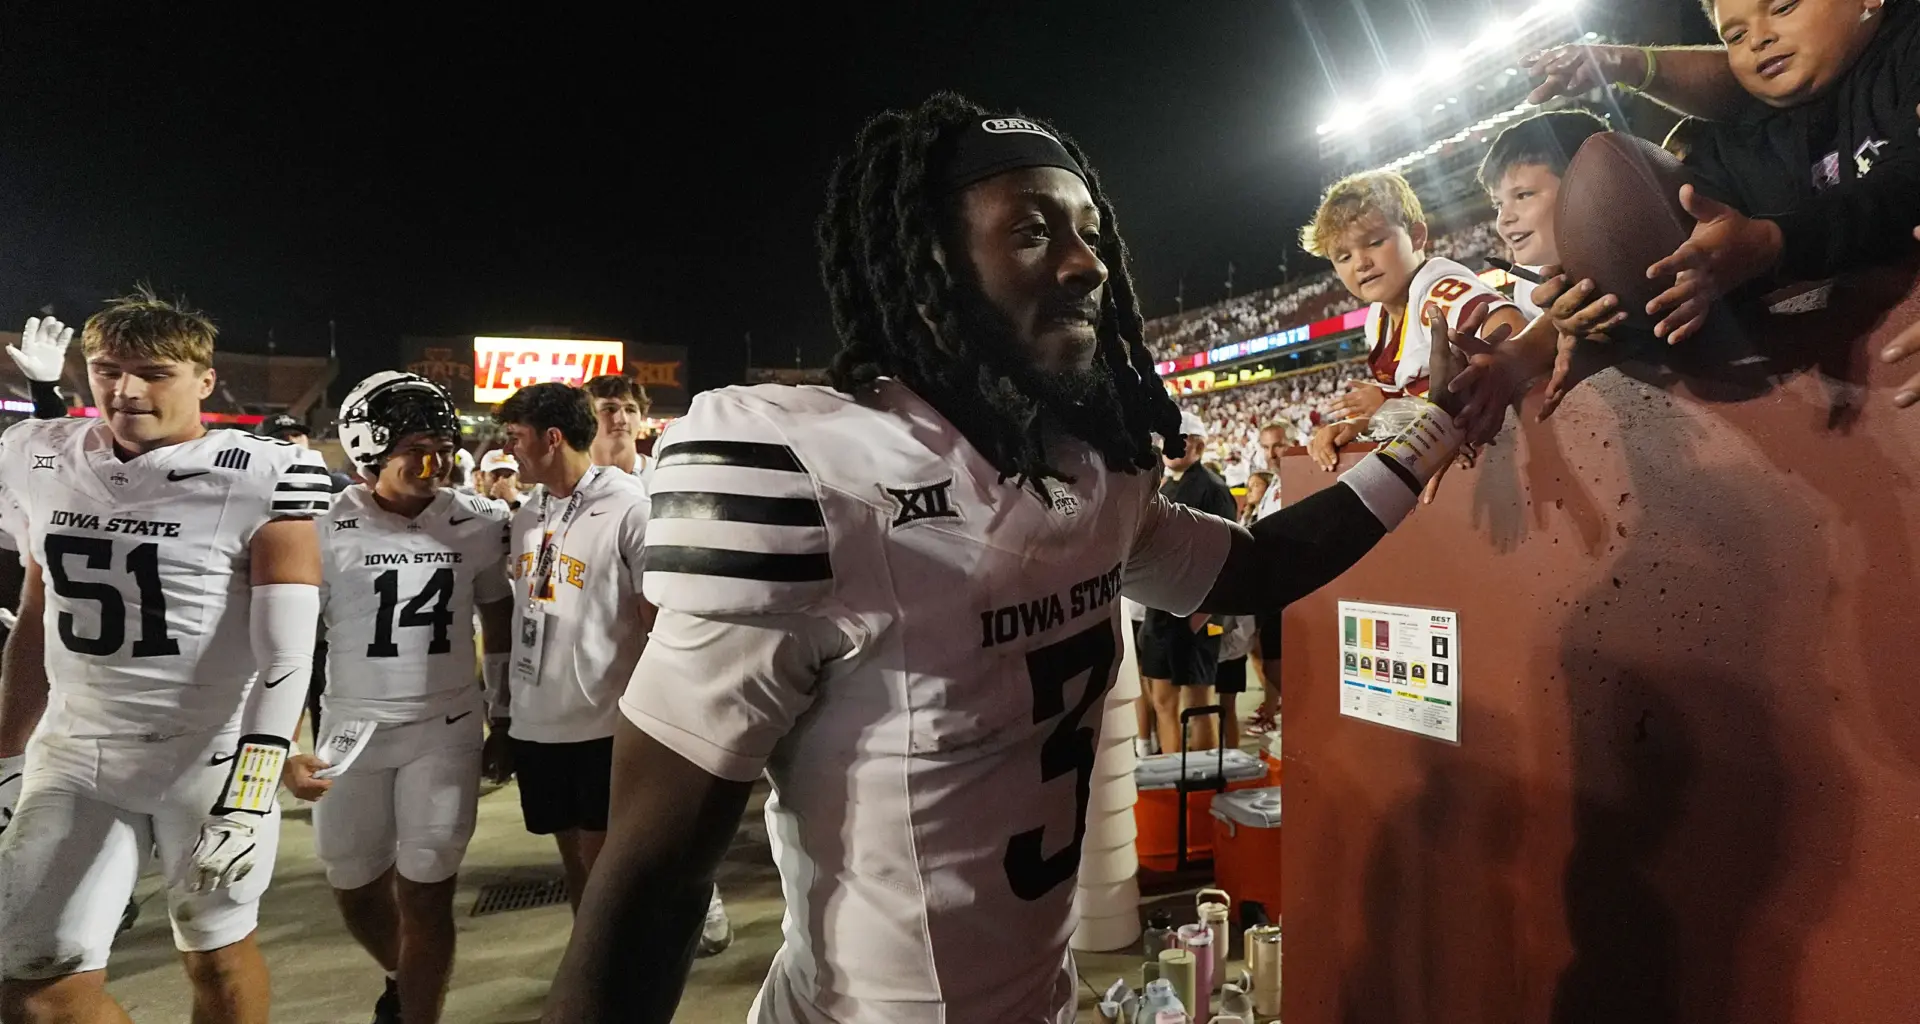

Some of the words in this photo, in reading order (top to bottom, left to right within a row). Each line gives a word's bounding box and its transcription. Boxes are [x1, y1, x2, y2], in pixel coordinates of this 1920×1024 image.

[993, 119, 1045, 132] BATT
[32, 455, 56, 469] XII
[886, 477, 960, 528] XII
[50, 510, 99, 530] IOWA
[104, 517, 181, 537] STATE
[334, 518, 360, 531] XII
[365, 553, 409, 566] IOWA
[414, 552, 463, 564] STATE
[44, 533, 181, 658] 51
[366, 568, 455, 658] 14
[980, 593, 1065, 648] IOWA
[1430, 615, 1451, 623] BEST
[1003, 617, 1117, 901] 3
